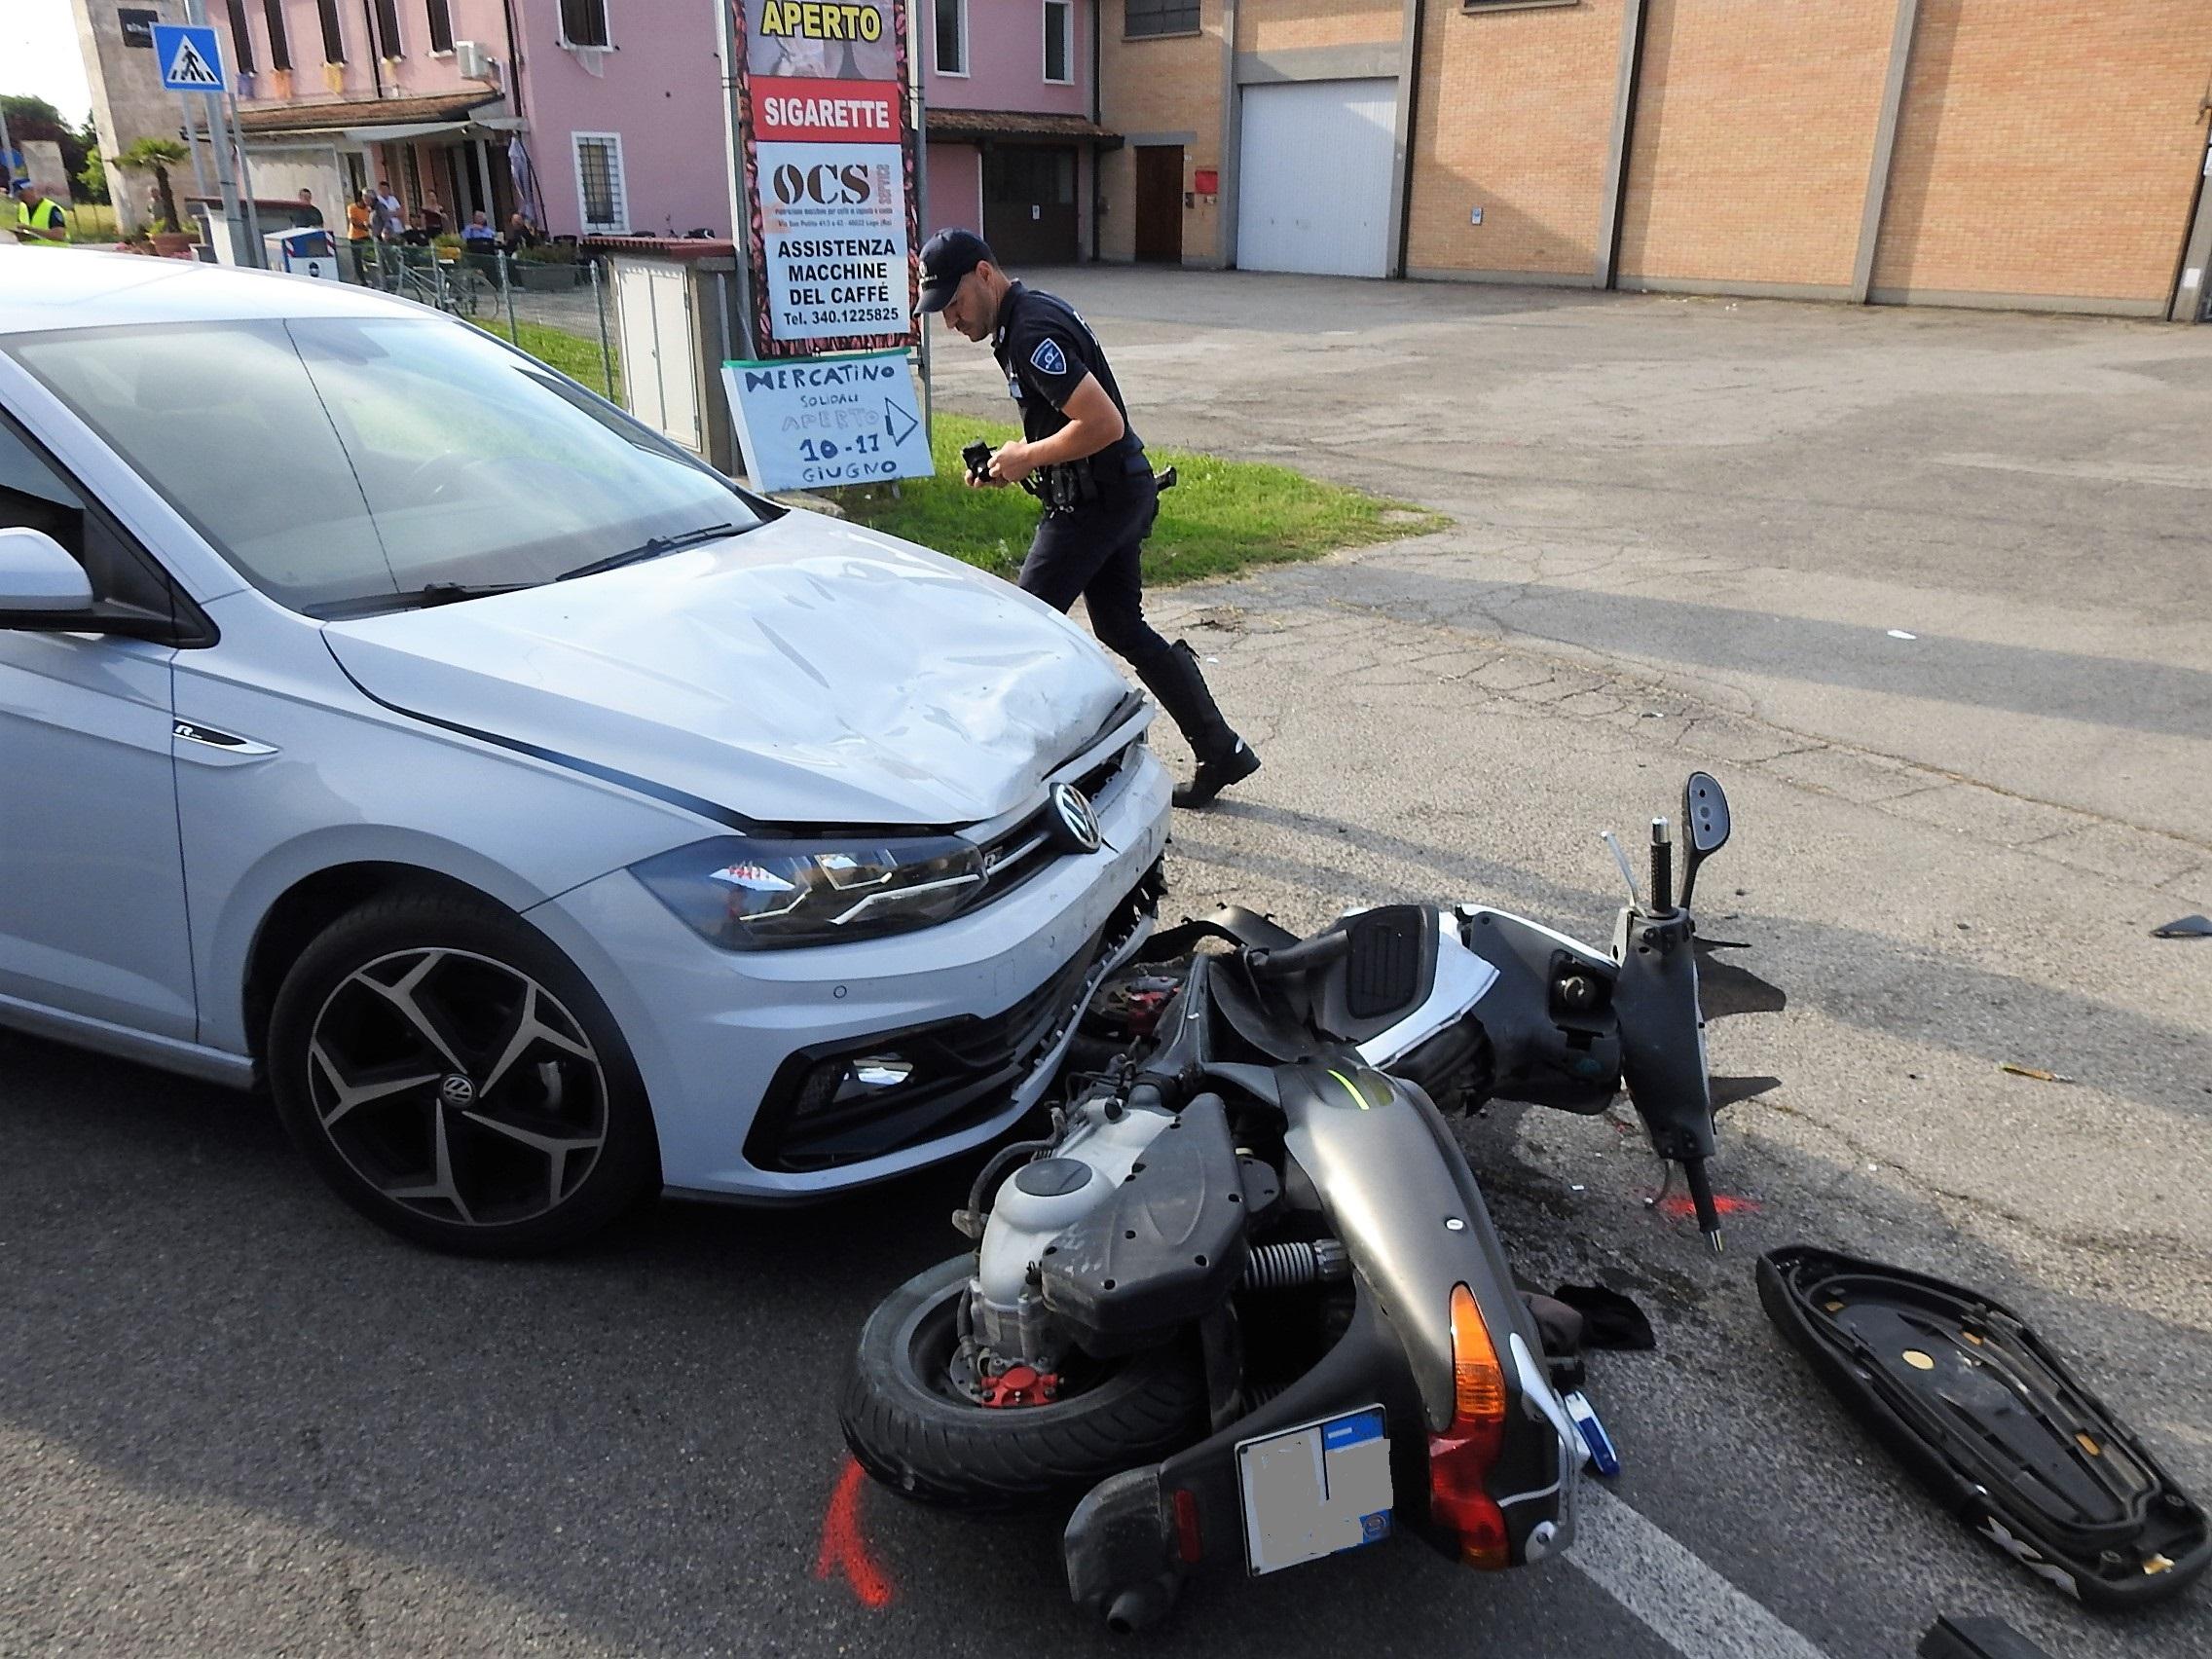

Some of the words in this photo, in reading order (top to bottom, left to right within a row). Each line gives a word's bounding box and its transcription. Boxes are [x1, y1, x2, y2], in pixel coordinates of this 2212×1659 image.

[761, 0, 882, 40] APERTO
[764, 97, 890, 129] SIGARETTE
[773, 164, 871, 204] OCS
[778, 239, 896, 258] ASSISTENZA
[789, 263, 888, 282] MACCHINE
[790, 288, 825, 306] DEL
[784, 311, 808, 326] Tel.
[812, 307, 899, 325] 340.1225825
